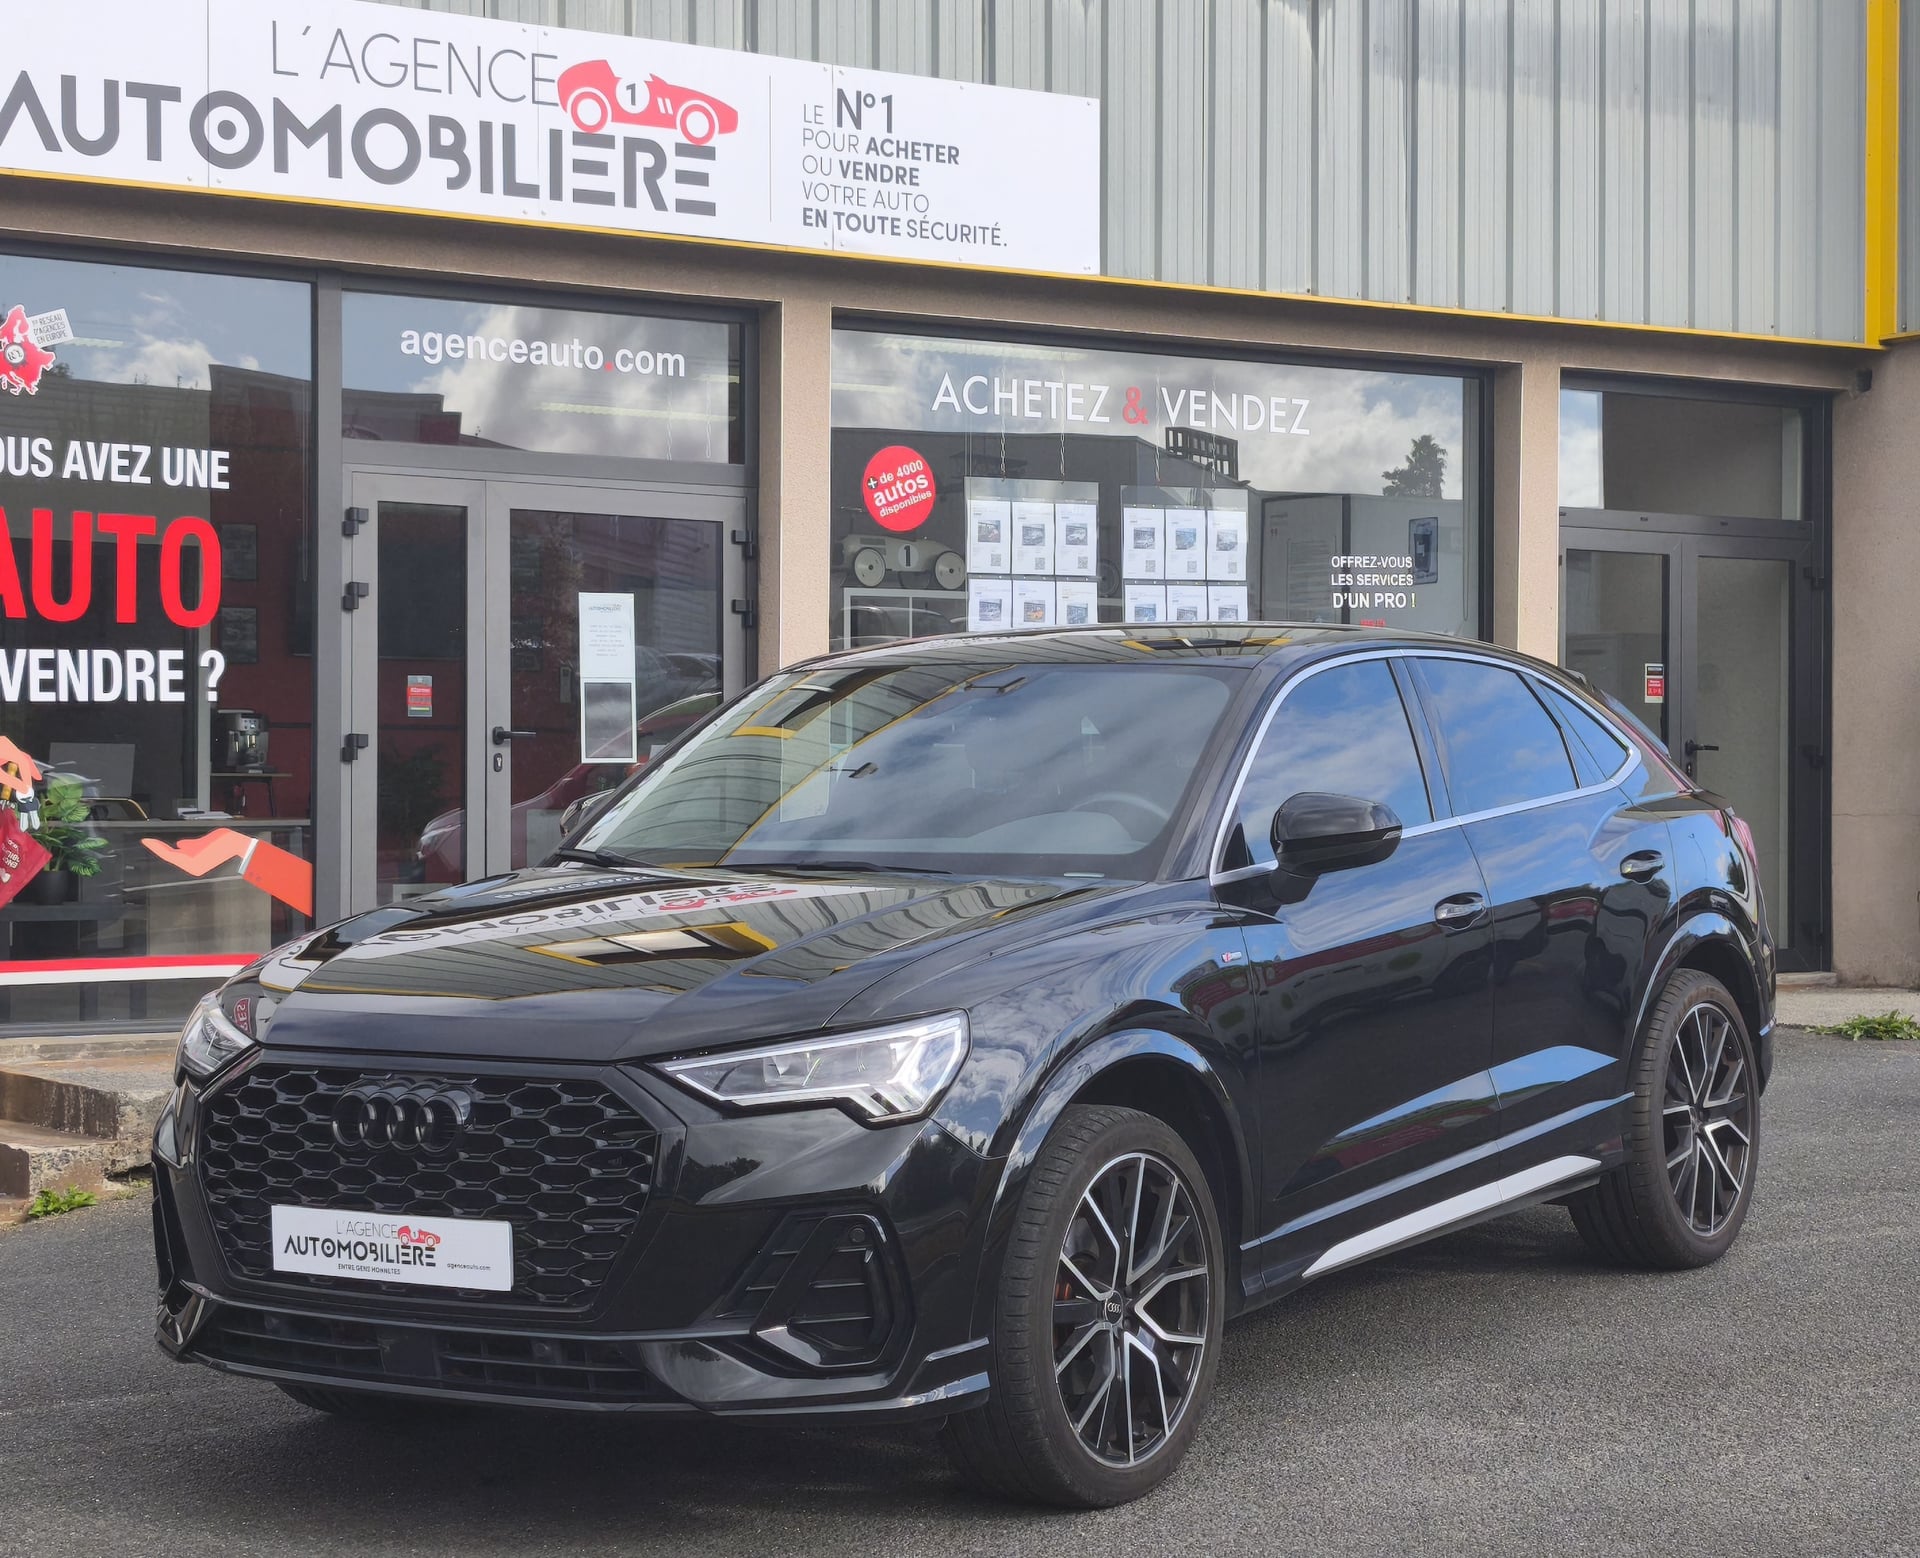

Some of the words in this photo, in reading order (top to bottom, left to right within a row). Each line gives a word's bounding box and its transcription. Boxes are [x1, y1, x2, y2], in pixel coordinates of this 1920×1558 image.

[272, 20, 560, 107] L'AGENCE
[804, 104, 824, 125] LE
[803, 128, 859, 153] POUR
[866, 136, 960, 165] ACHETER
[802, 155, 832, 176] OU
[839, 160, 920, 186] VENDRE
[802, 181, 867, 207] VOTRE
[873, 189, 929, 214] AUTO
[803, 207, 828, 229] EN
[834, 211, 901, 237] TOUTE
[906, 215, 1008, 247] SÉCURITÉ.
[400, 329, 686, 377] agenceauto.com
[931, 372, 1110, 423] ACHETEZ
[1122, 386, 1149, 425] &
[1161, 387, 1310, 435] VENDEZ
[0, 436, 54, 479] US
[62, 441, 151, 484] AVEZ
[162, 447, 230, 489] UNE
[880, 472, 894, 484] de
[897, 459, 924, 477] 4000
[873, 474, 929, 507] autos
[880, 490, 932, 517] disponibles
[1331, 556, 1413, 568] OFFREZ-VOUS
[1331, 574, 1353, 586] LES
[1356, 574, 1414, 586] SERVICES
[1332, 592, 1370, 608] D'UN
[1374, 592, 1407, 608] PRO
[1411, 592, 1416, 608] !
[200, 650, 225, 702] ?
